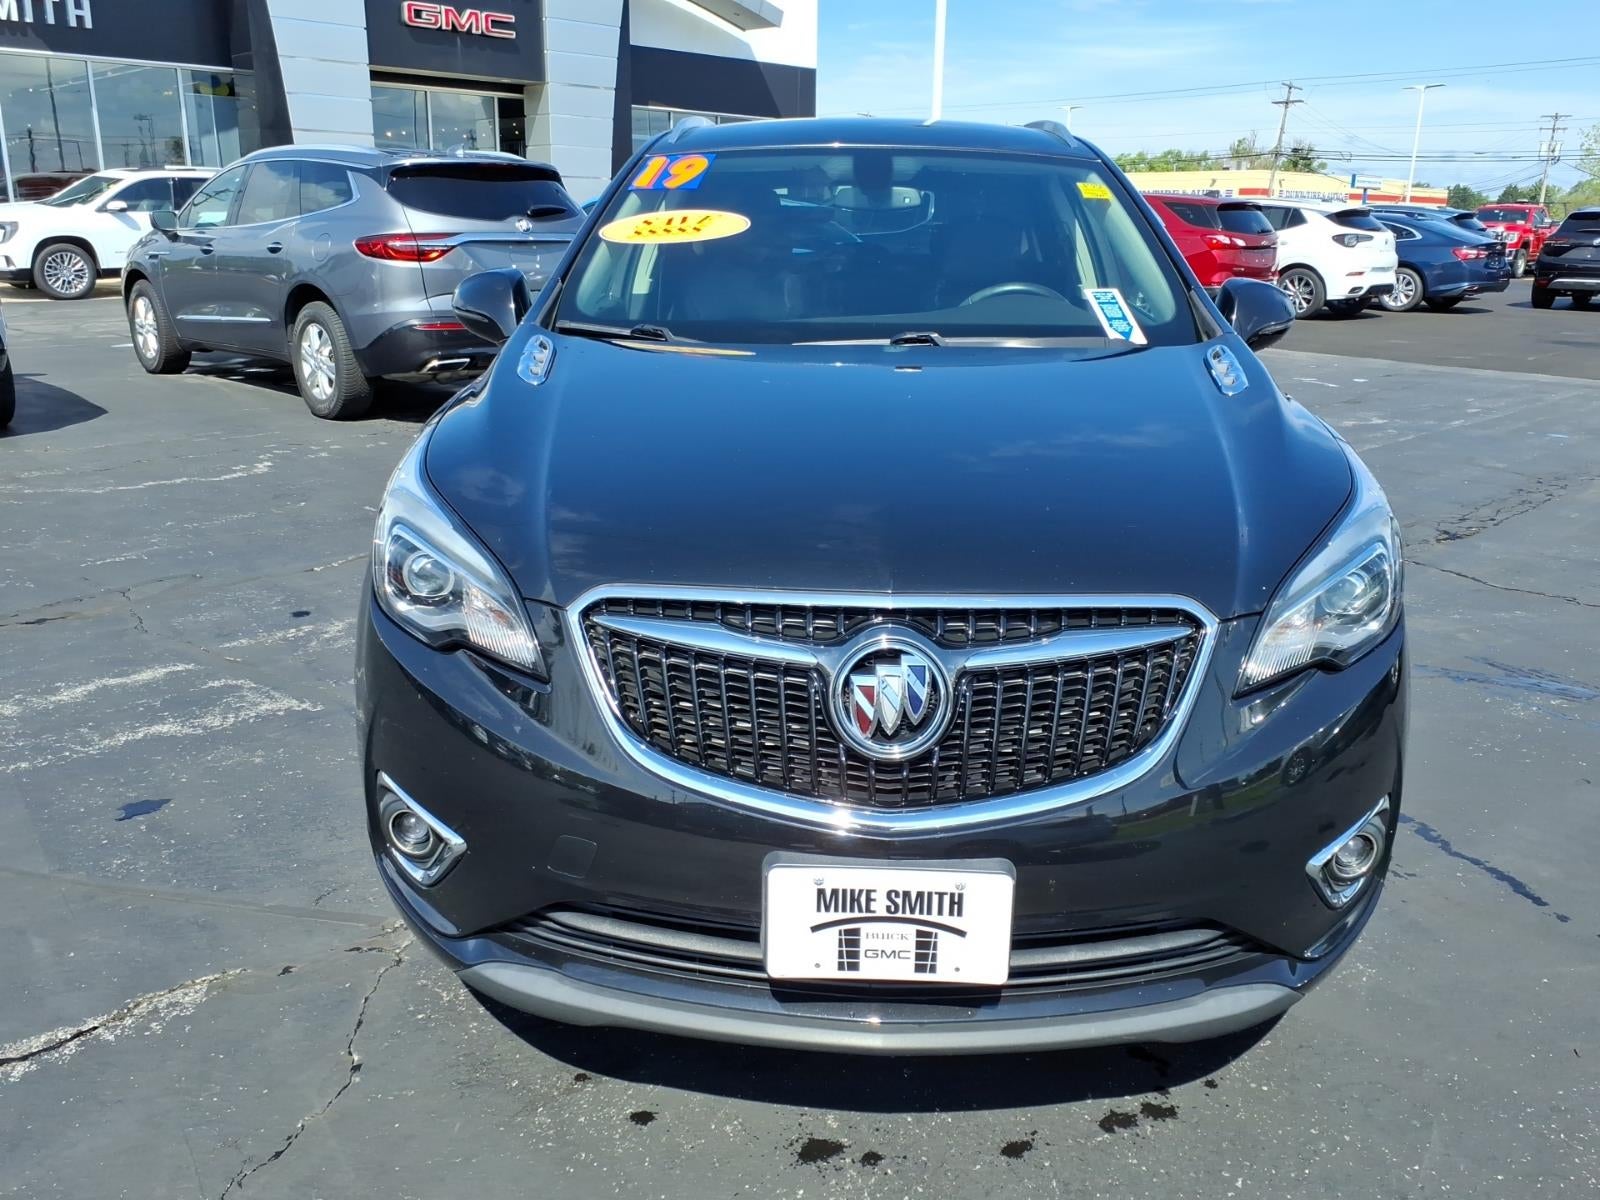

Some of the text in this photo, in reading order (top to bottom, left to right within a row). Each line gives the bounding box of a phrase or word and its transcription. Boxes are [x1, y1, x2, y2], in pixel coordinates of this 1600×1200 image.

[402, 1, 516, 39] GMC
[632, 154, 709, 190] 19
[816, 888, 964, 917] MIKE SMITH
[865, 932, 909, 942] BUICK
[864, 949, 911, 960] GMC
